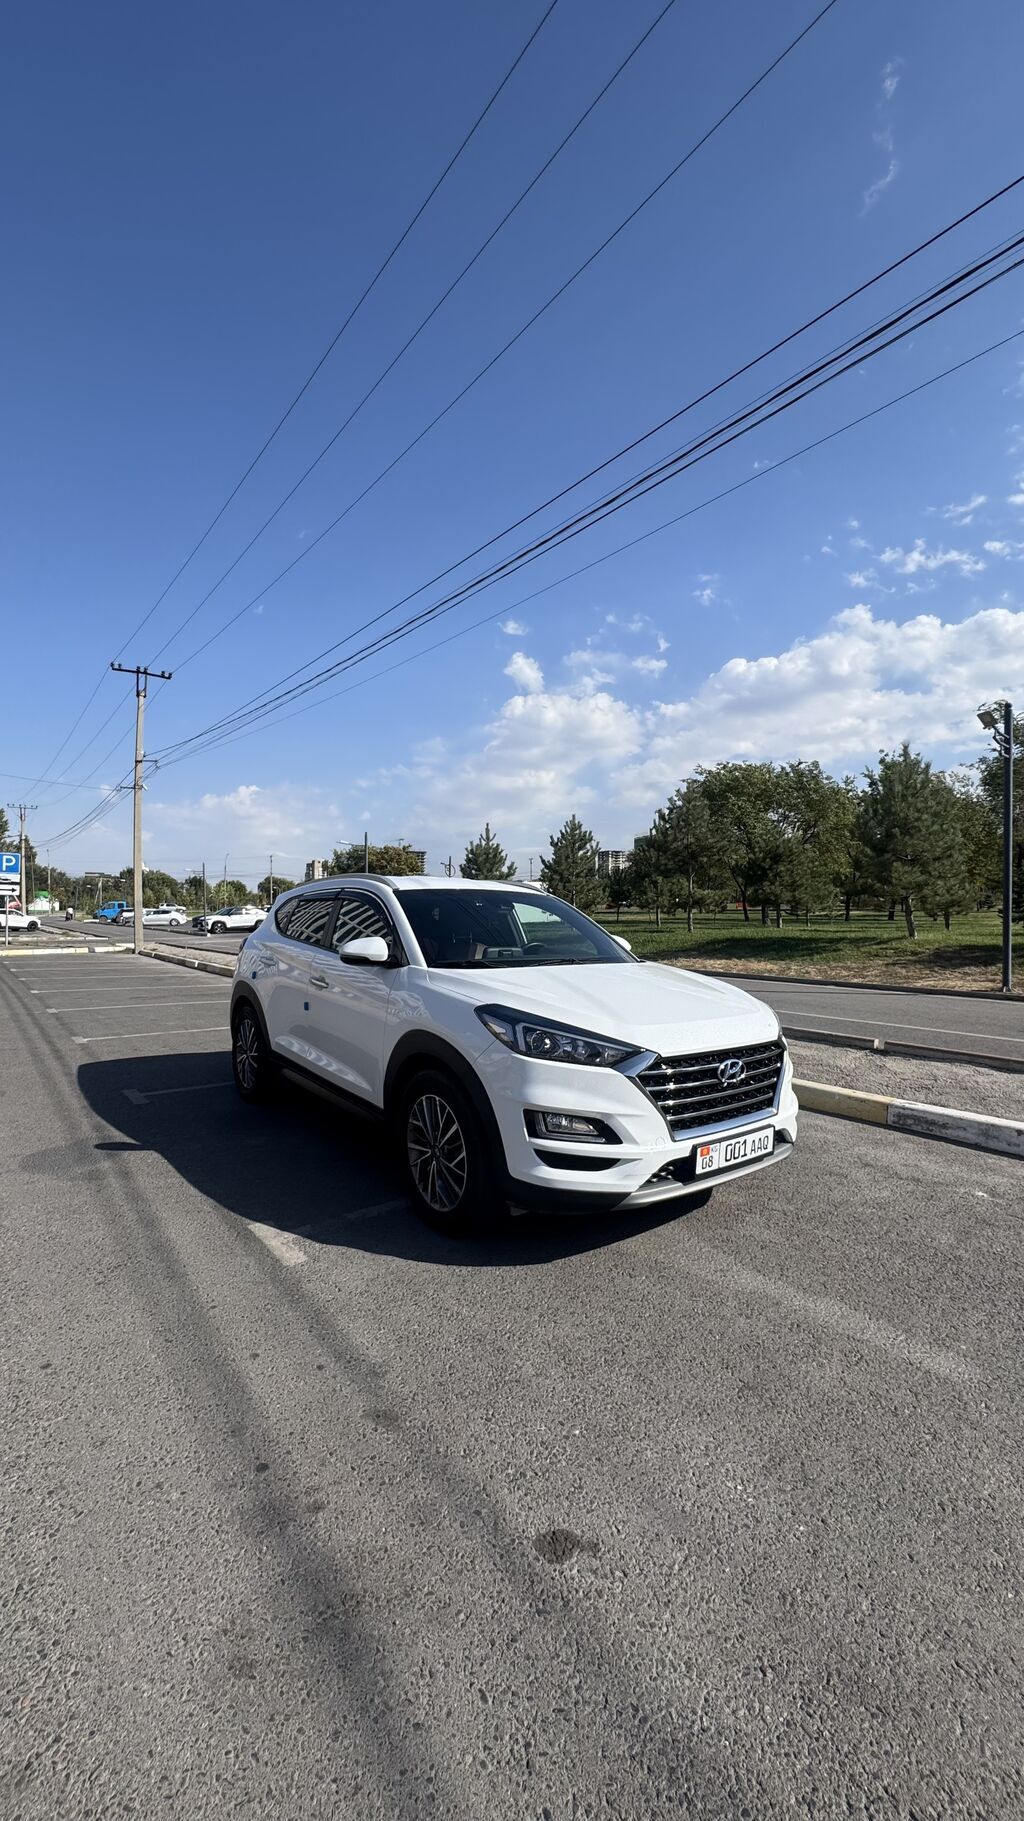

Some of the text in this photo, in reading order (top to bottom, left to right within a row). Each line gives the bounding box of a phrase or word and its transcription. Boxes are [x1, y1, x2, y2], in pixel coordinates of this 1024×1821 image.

[2, 855, 16, 871] P
[725, 1139, 748, 1163] 001
[701, 1156, 714, 1170] 08
